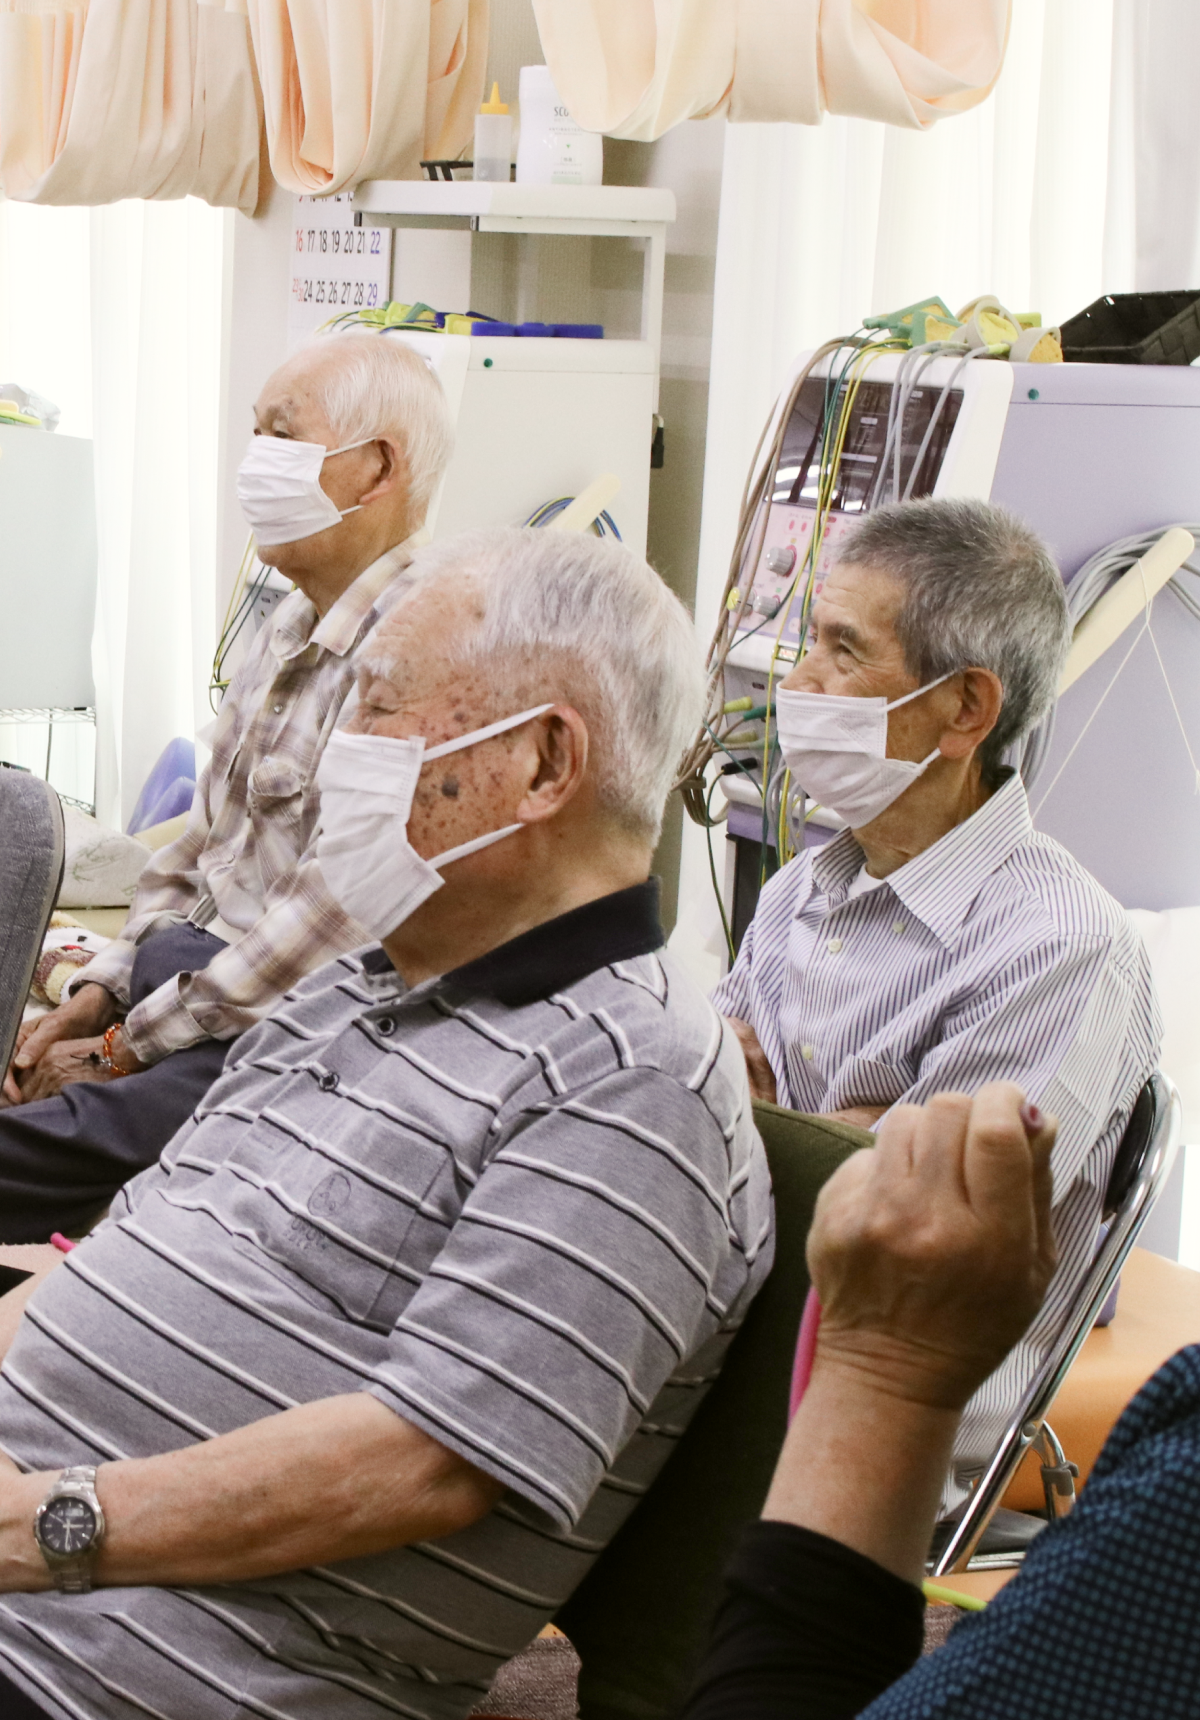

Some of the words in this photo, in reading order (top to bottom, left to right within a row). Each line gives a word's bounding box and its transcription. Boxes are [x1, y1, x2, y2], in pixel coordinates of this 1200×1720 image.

[296, 229, 303, 252] 16
[307, 230, 315, 252] 17
[319, 230, 327, 252] 18
[331, 230, 340, 253] 19
[344, 230, 354, 253] 20
[357, 231, 365, 254] 21
[370, 231, 380, 254] 22
[303, 280, 312, 302] 24
[316, 280, 325, 303] 25
[328, 281, 337, 304] 26
[341, 282, 351, 305] 27
[354, 282, 364, 306] 28
[367, 283, 377, 306] 29
